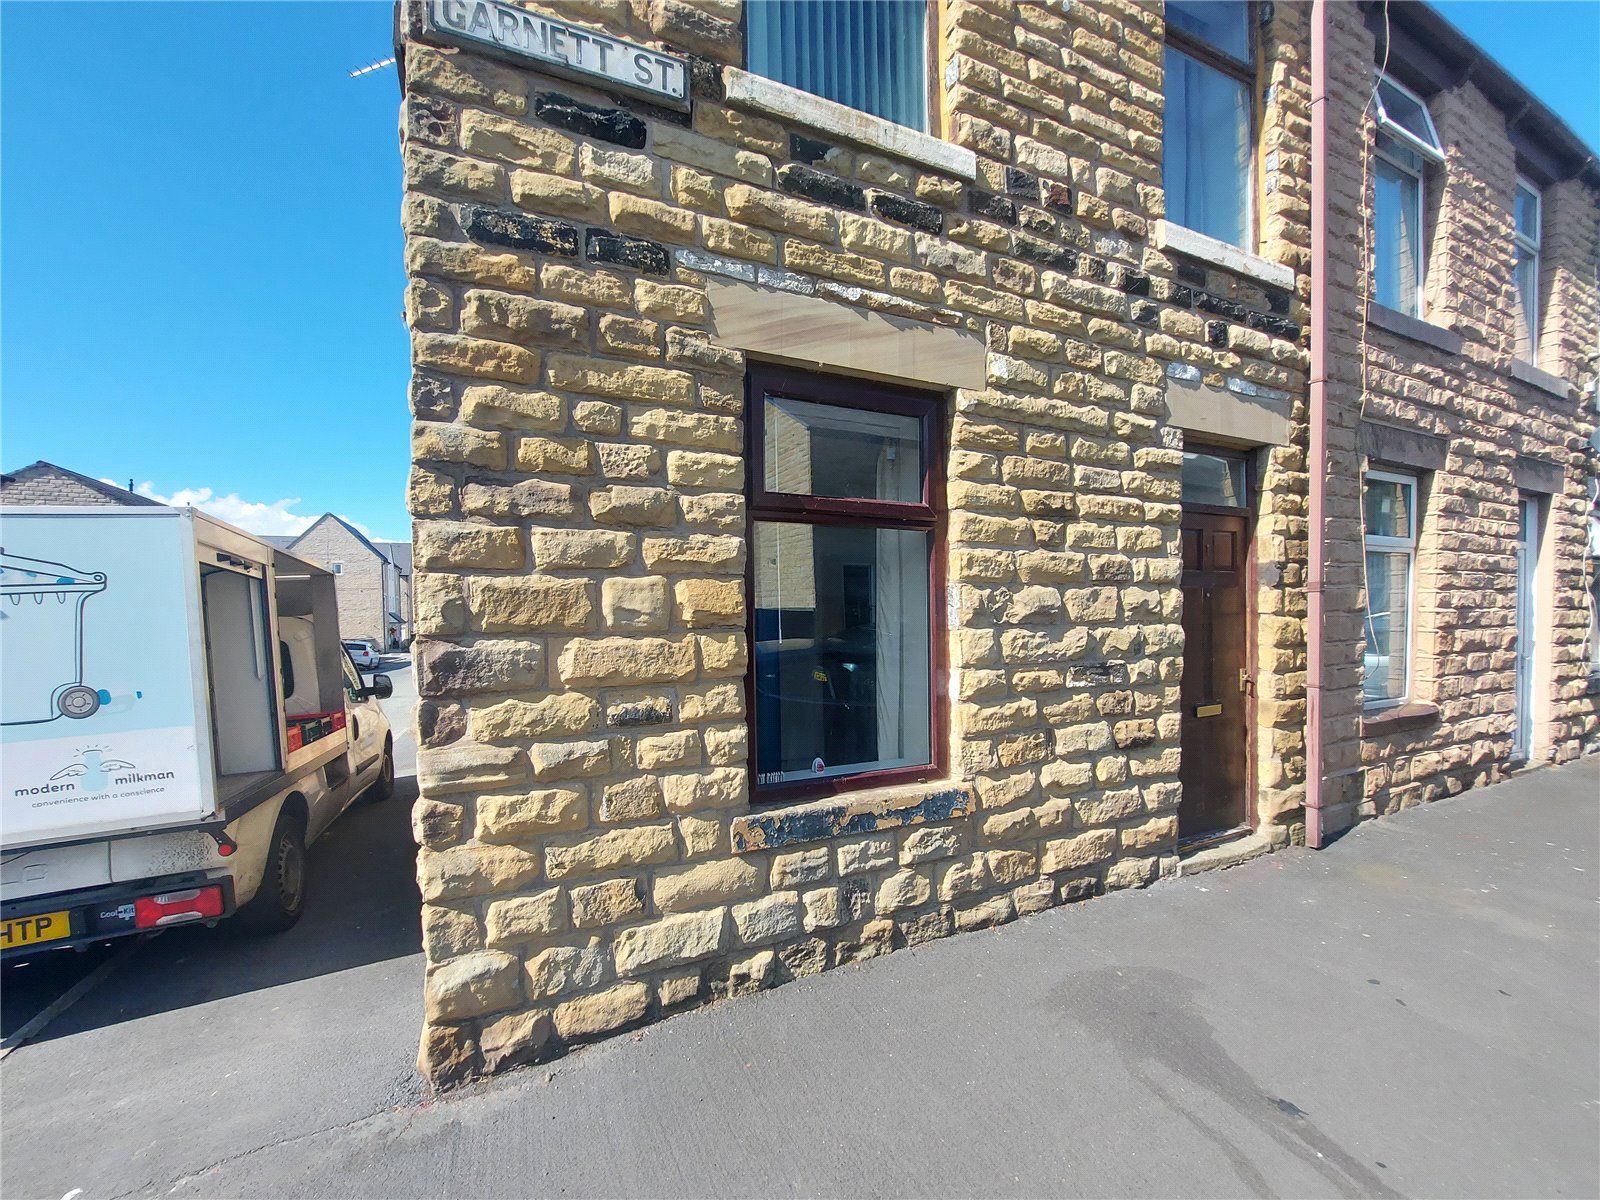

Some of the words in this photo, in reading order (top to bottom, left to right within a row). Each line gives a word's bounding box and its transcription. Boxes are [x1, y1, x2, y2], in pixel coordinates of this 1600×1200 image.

[442, 0, 613, 74] GARNETT
[14, 782, 75, 797] modern
[114, 770, 175, 786] milkman
[31, 795, 89, 809] convenience
[90, 792, 111, 801] with
[120, 787, 165, 798] conscience
[0, 916, 53, 944] HTP
